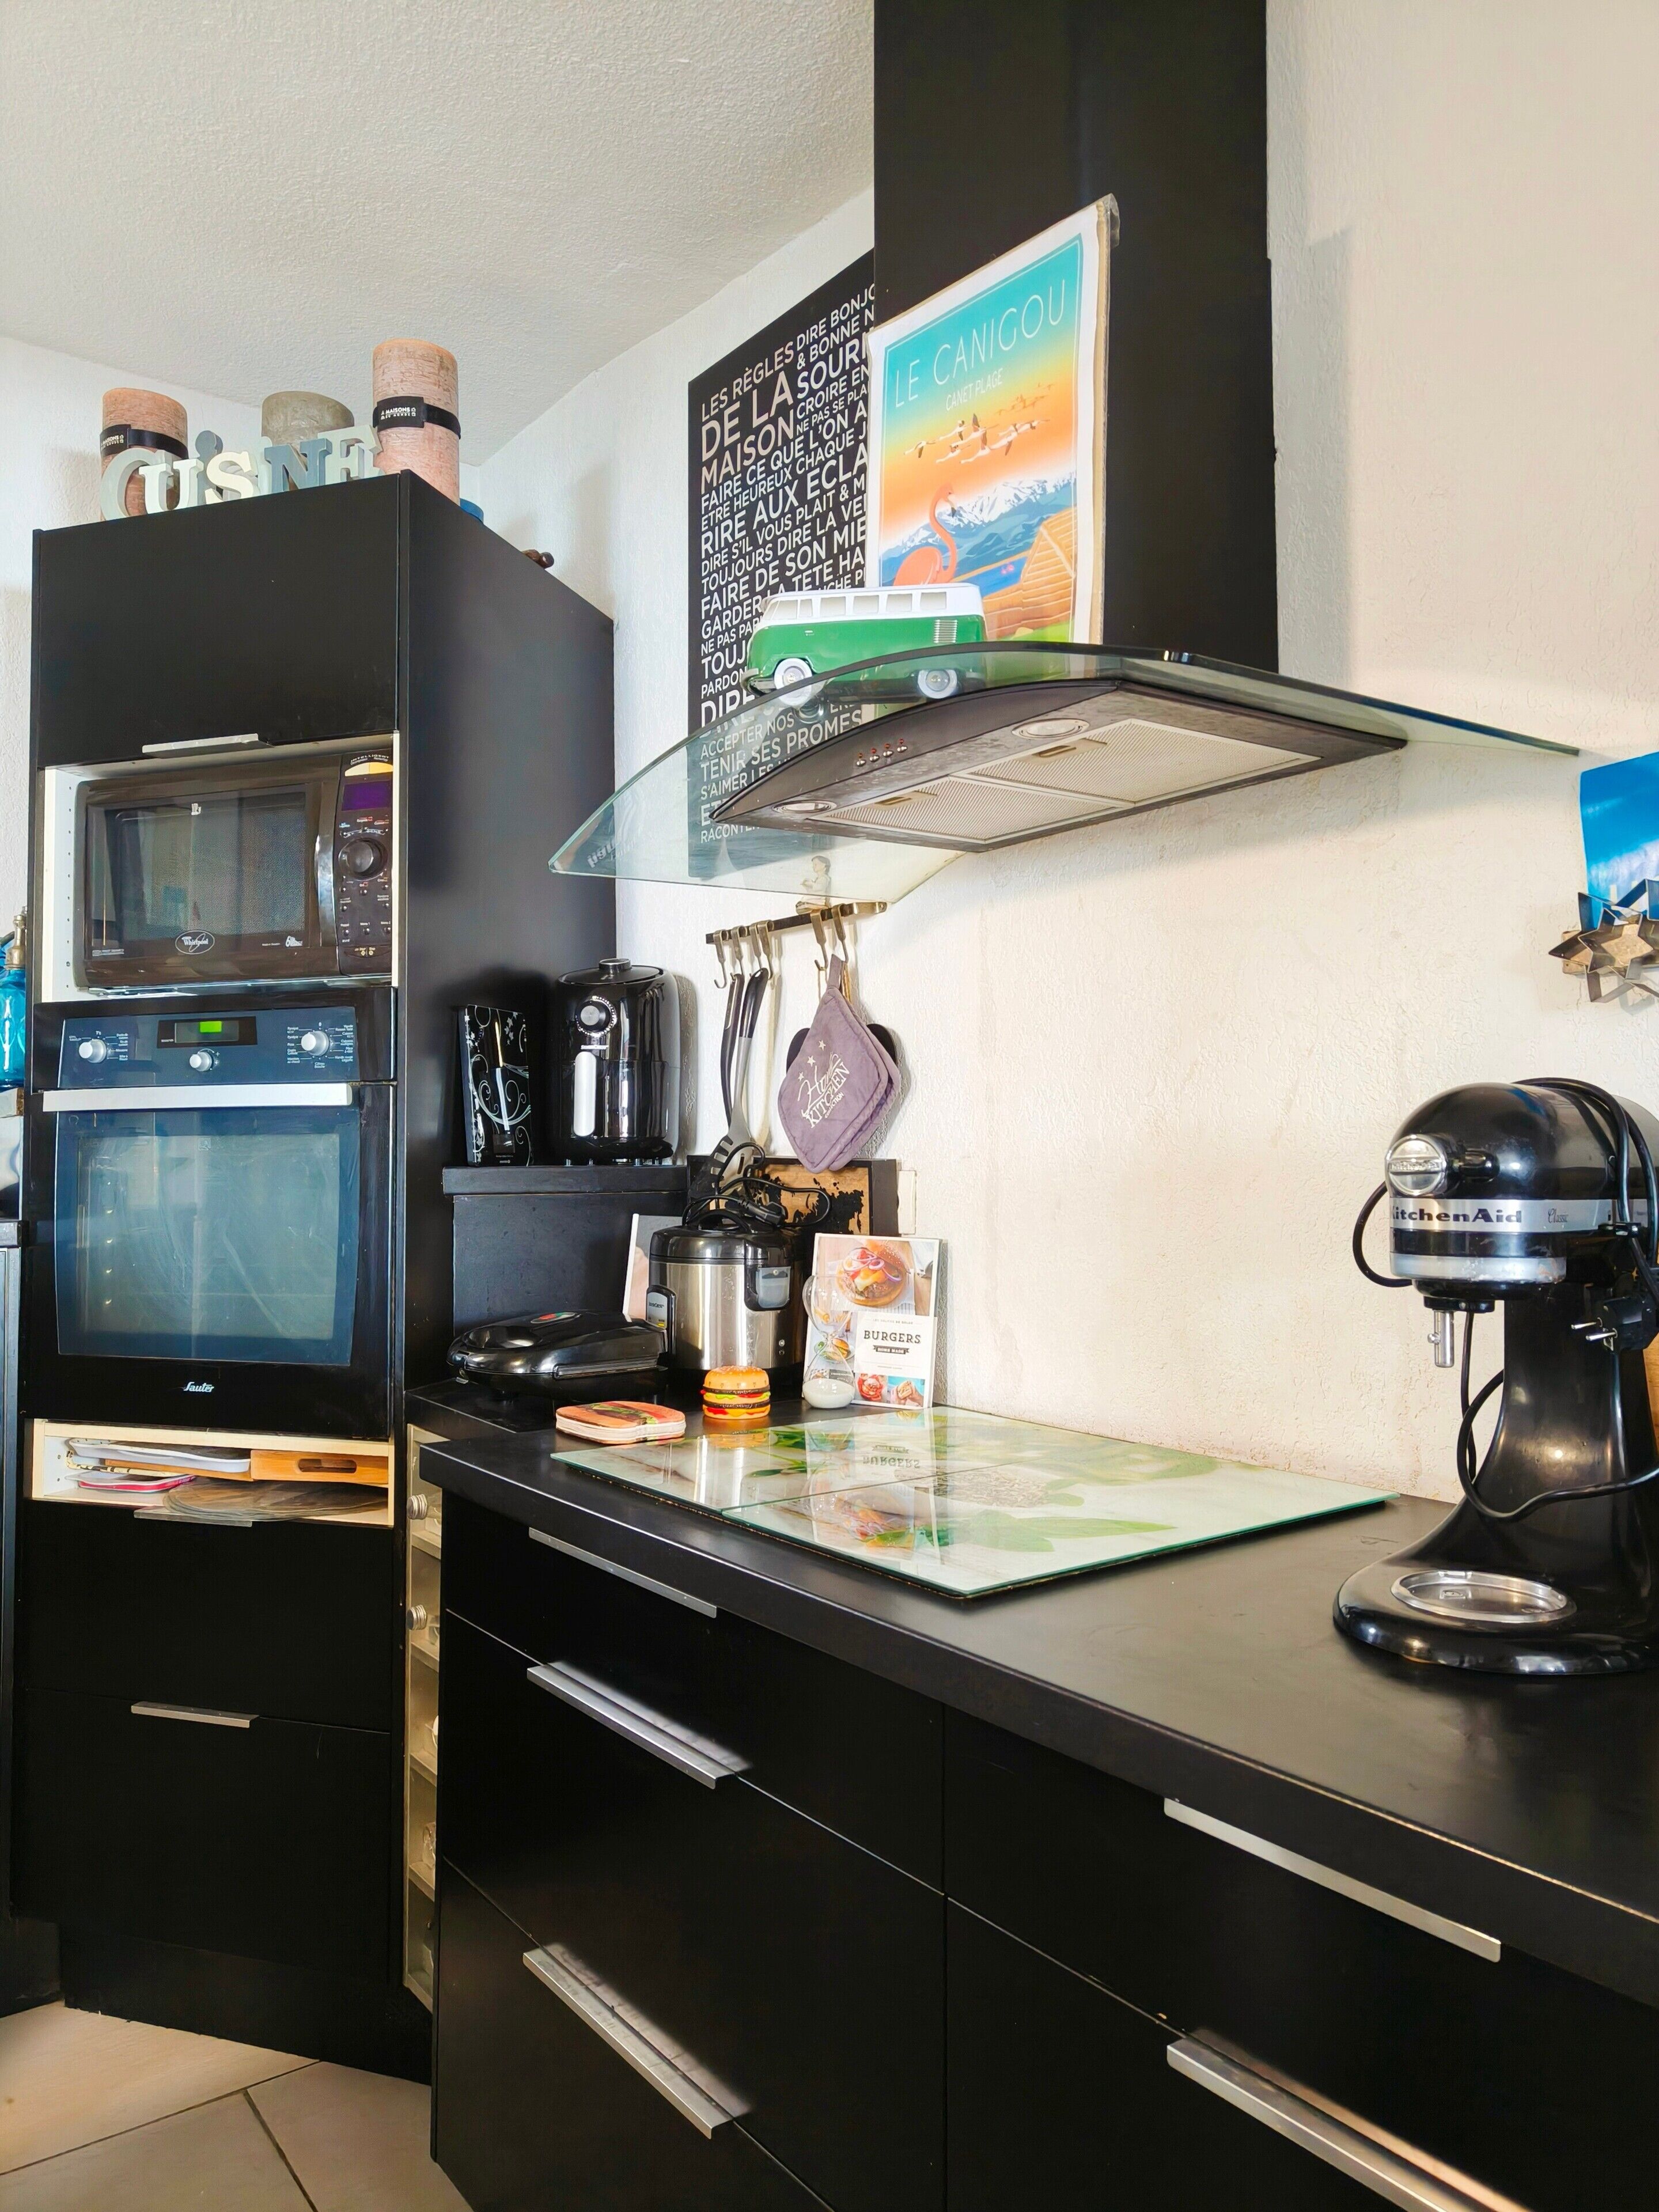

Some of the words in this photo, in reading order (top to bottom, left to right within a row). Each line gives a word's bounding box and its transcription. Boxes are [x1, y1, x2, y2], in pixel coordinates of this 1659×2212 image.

[797, 318, 827, 350] DIRE
[809, 315, 860, 362] BONNE
[896, 359, 920, 408] LE
[933, 279, 1065, 385] CANIGOU
[702, 388, 728, 422] LES
[733, 340, 794, 400] RÈGLES
[797, 327, 874, 399] SOURI
[702, 401, 741, 461] DE
[752, 370, 794, 428] LA
[797, 374, 847, 419] CROIRE
[797, 421, 809, 436] NE
[811, 406, 830, 426] PAS
[832, 398, 844, 414] SE
[847, 384, 867, 406] PLA
[946, 383, 974, 411] CANET
[976, 368, 1003, 397] PLAGE
[701, 409, 794, 495] MAISON
[702, 474, 741, 514] FAIRE
[746, 459, 766, 486] CE
[771, 435, 804, 471] QUE
[702, 501, 730, 532] ETRE
[734, 464, 792, 512] HEUREUX
[796, 428, 855, 475] CHAQUE
[702, 510, 747, 559] RIRE
[753, 479, 799, 529] AUX
[807, 442, 868, 500] ECLA
[702, 548, 728, 577] DIRE
[732, 537, 753, 559] S'IL
[756, 514, 792, 545] VOUS
[796, 490, 835, 525] PLAIT
[702, 543, 773, 594] TOUJOURS
[778, 522, 812, 556] DIRE
[817, 511, 836, 536] LA
[702, 575, 749, 619] FAIRE
[756, 559, 779, 592] DE
[785, 536, 825, 576] SON
[702, 594, 763, 639] GARDER
[791, 559, 834, 592] TETE
[701, 641, 714, 657] NE
[717, 628, 736, 650] PAS
[701, 640, 745, 679] TOUJ
[700, 724, 763, 760] ACCEPTER
[767, 712, 794, 736] NOS
[700, 750, 747, 782] TENIR
[751, 737, 781, 765] SES
[700, 772, 748, 801] S'AIMER
[1392, 1206, 1522, 1223] itchenAid
[863, 1330, 921, 1344] BURGERS
[183, 1381, 214, 1392] Sauter
